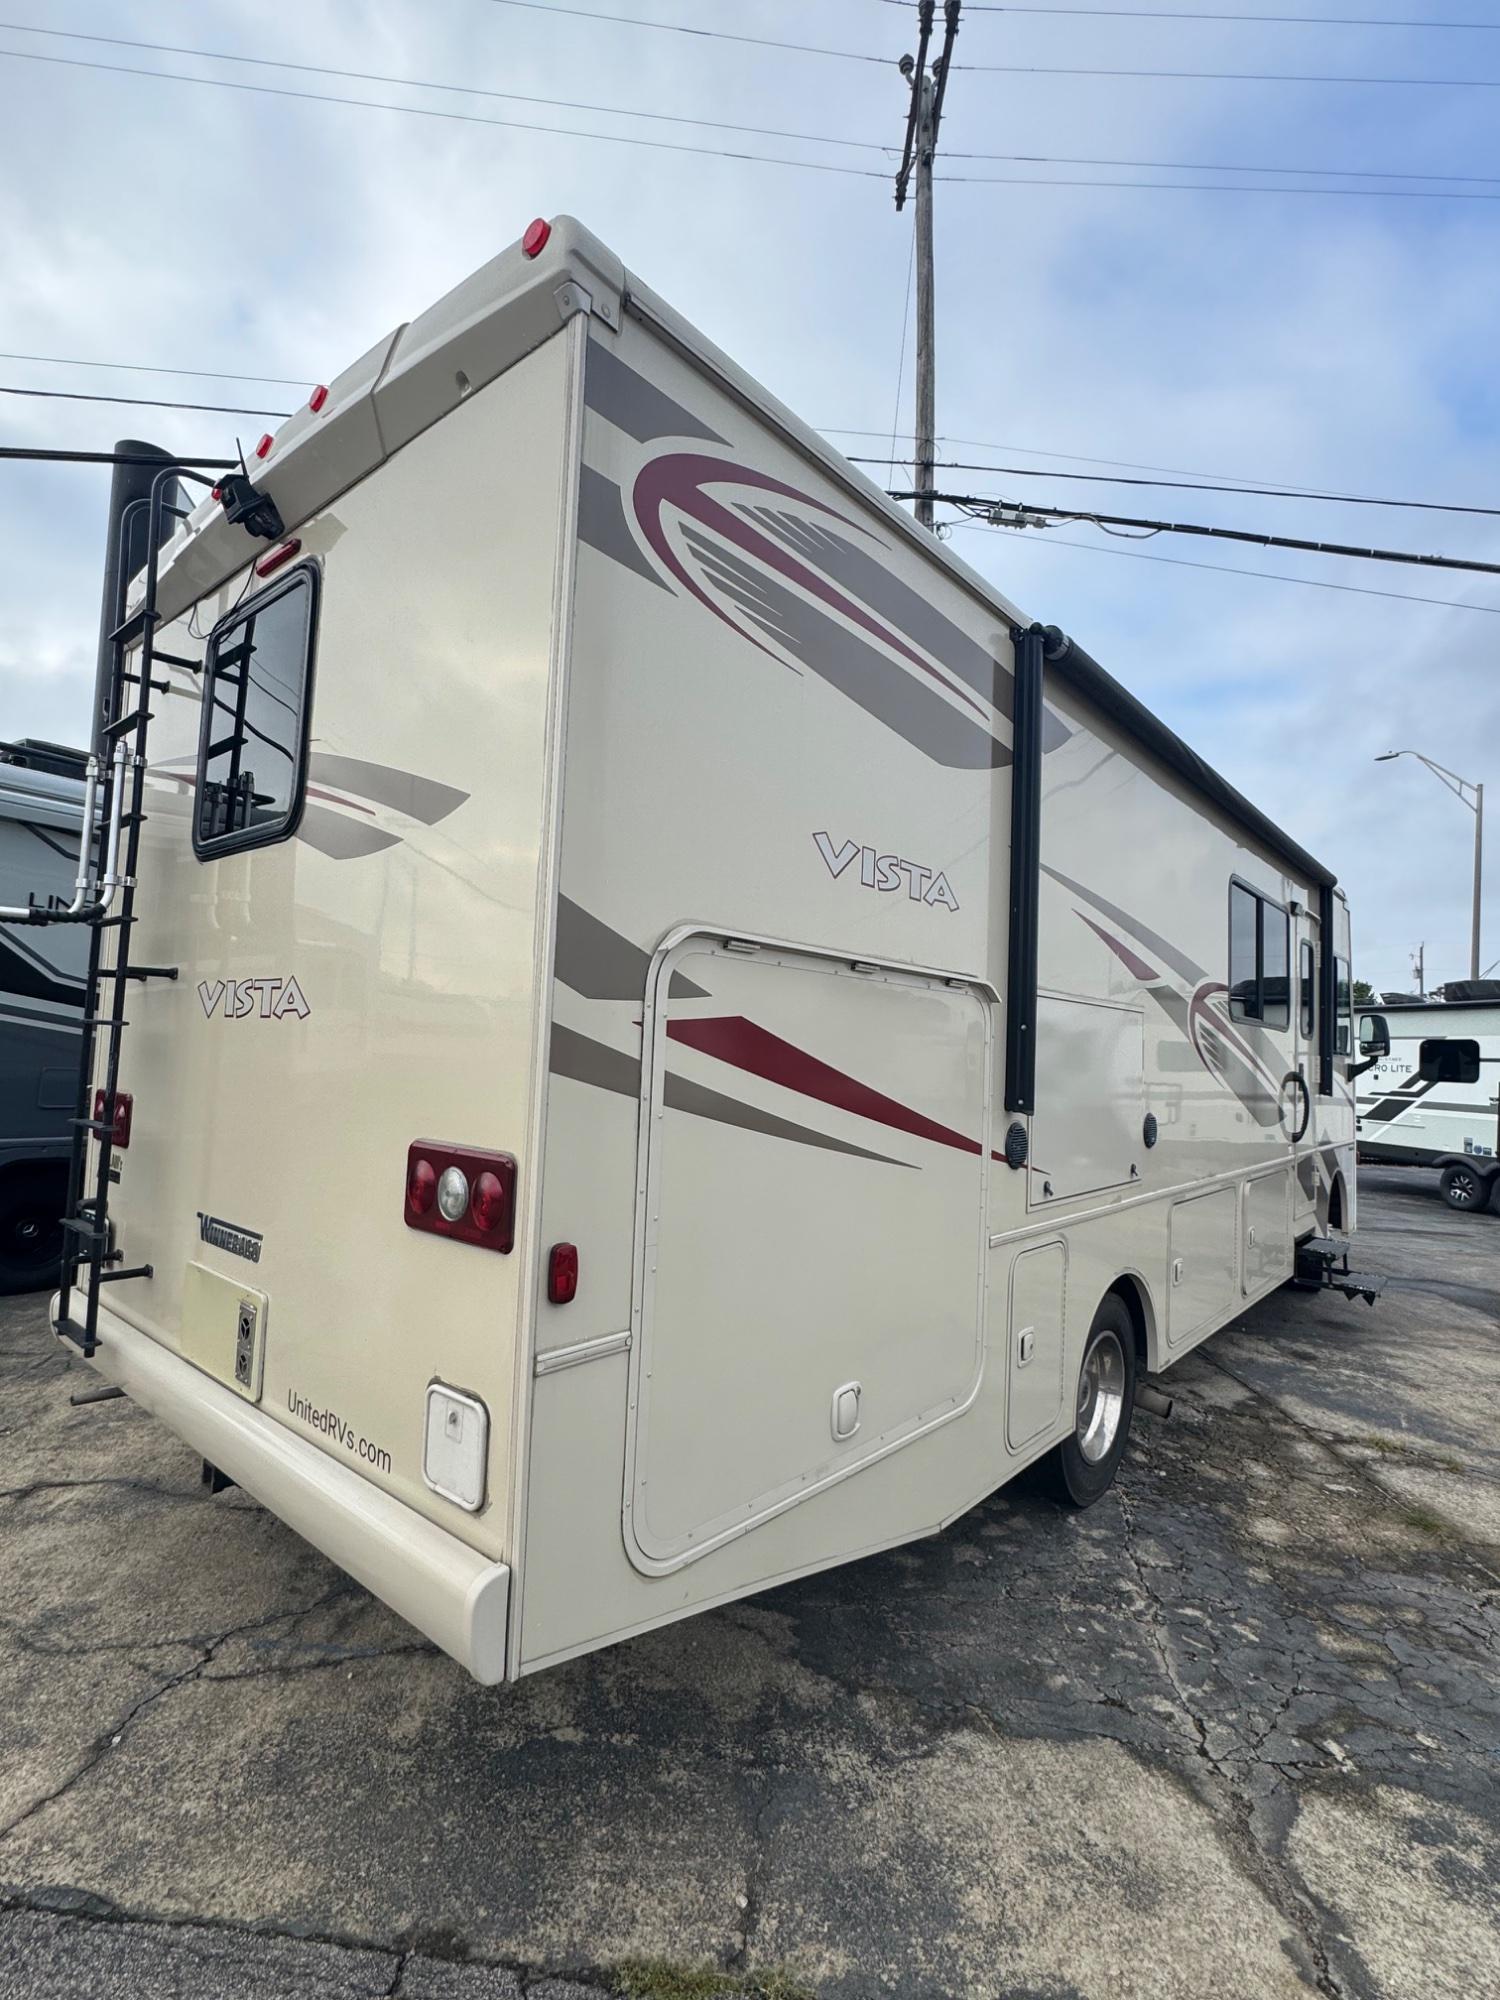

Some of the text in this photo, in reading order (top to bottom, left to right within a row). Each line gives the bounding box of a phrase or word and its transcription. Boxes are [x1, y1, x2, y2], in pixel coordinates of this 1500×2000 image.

[812, 831, 960, 913] VISTA
[198, 975, 311, 1020] VISTA
[1390, 1064, 1413, 1073] LITE
[288, 1388, 392, 1475] UnitedRVs.com
